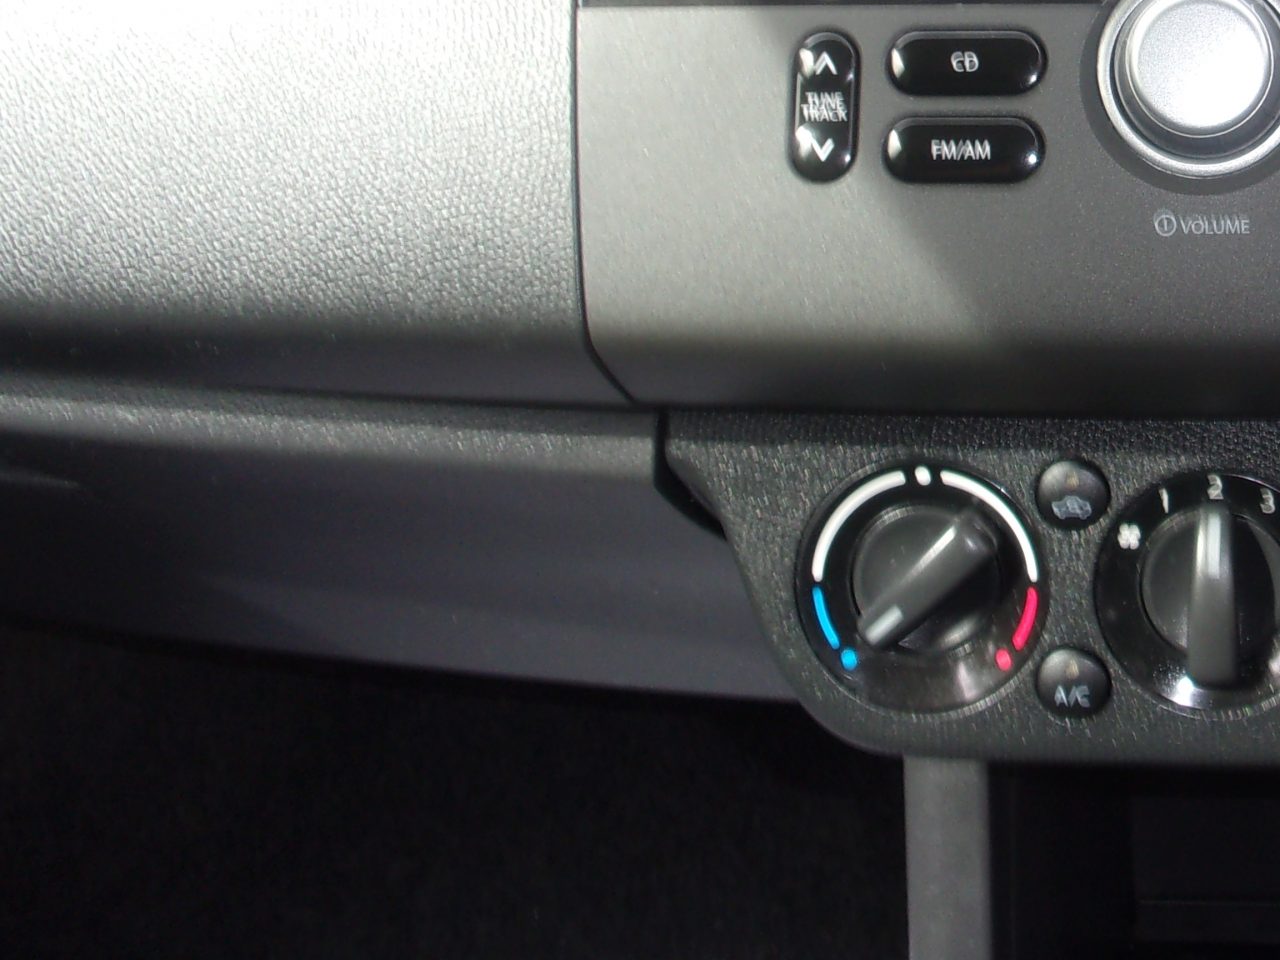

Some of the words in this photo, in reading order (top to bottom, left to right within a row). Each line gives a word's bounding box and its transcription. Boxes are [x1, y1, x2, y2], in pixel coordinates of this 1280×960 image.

[950, 50, 980, 73] CD
[931, 139, 992, 162] FM/AM
[1179, 215, 1251, 235] VOLUME
[1206, 474, 1224, 501] 2
[1158, 488, 1169, 514] 1
[1260, 488, 1277, 515] 3
[1054, 684, 1091, 709] A/C
